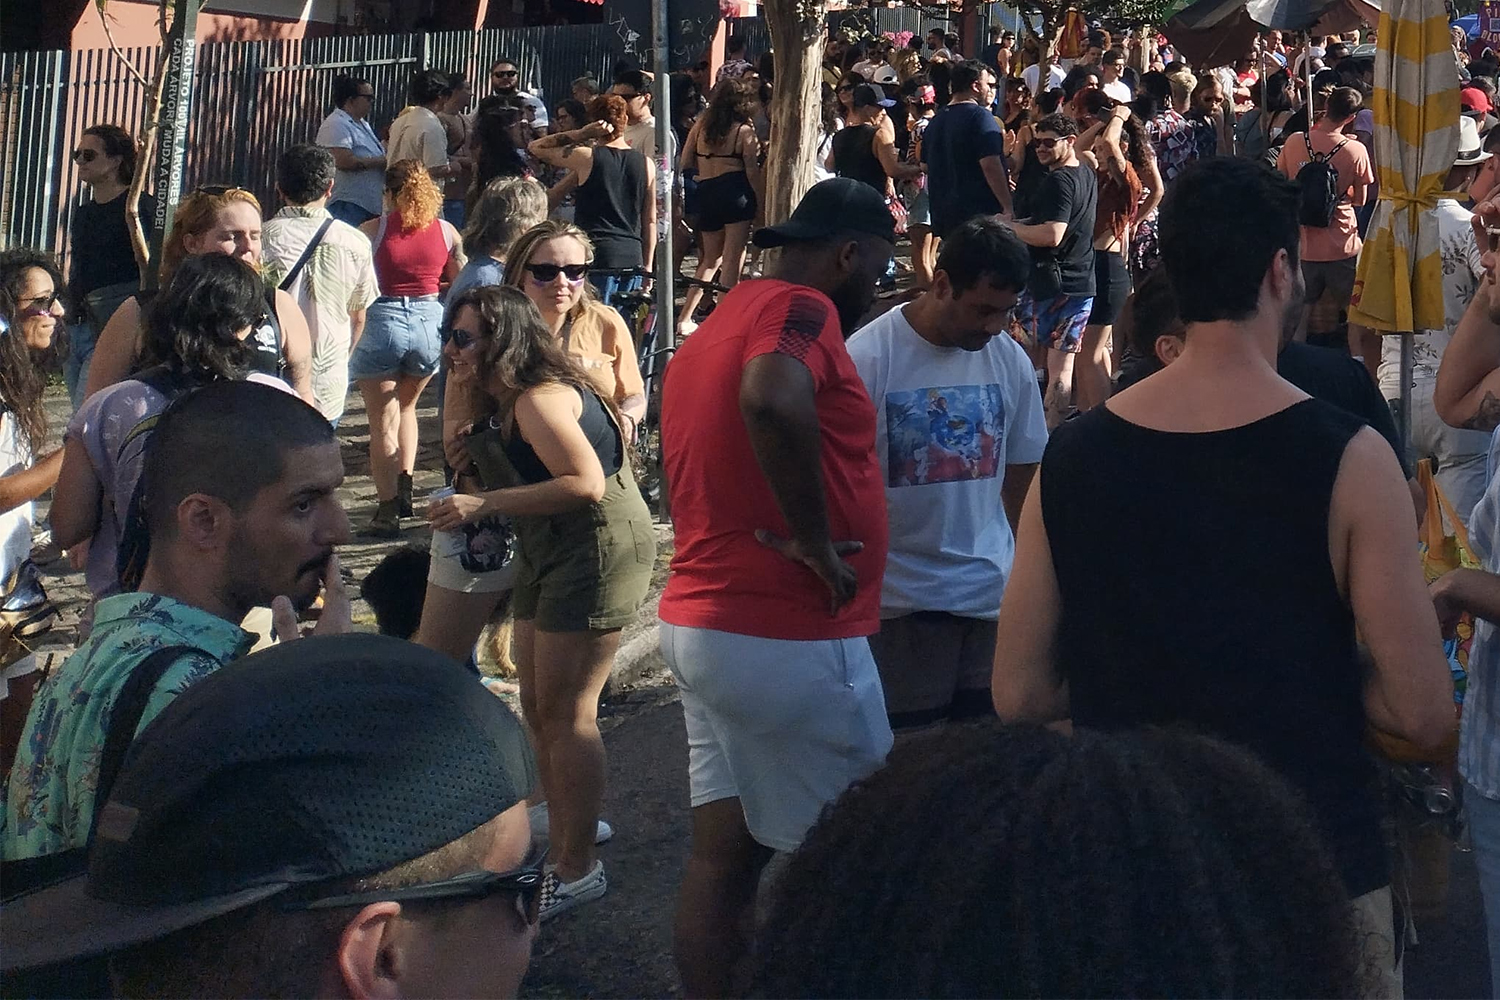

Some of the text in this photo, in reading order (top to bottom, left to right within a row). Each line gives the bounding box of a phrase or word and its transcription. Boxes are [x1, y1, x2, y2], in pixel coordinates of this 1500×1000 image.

[170, 38, 182, 72] CADA
[180, 38, 195, 97] PROJETO
[177, 99, 189, 119] 100
[160, 129, 174, 166] MUDA
[159, 167, 169, 178] A
